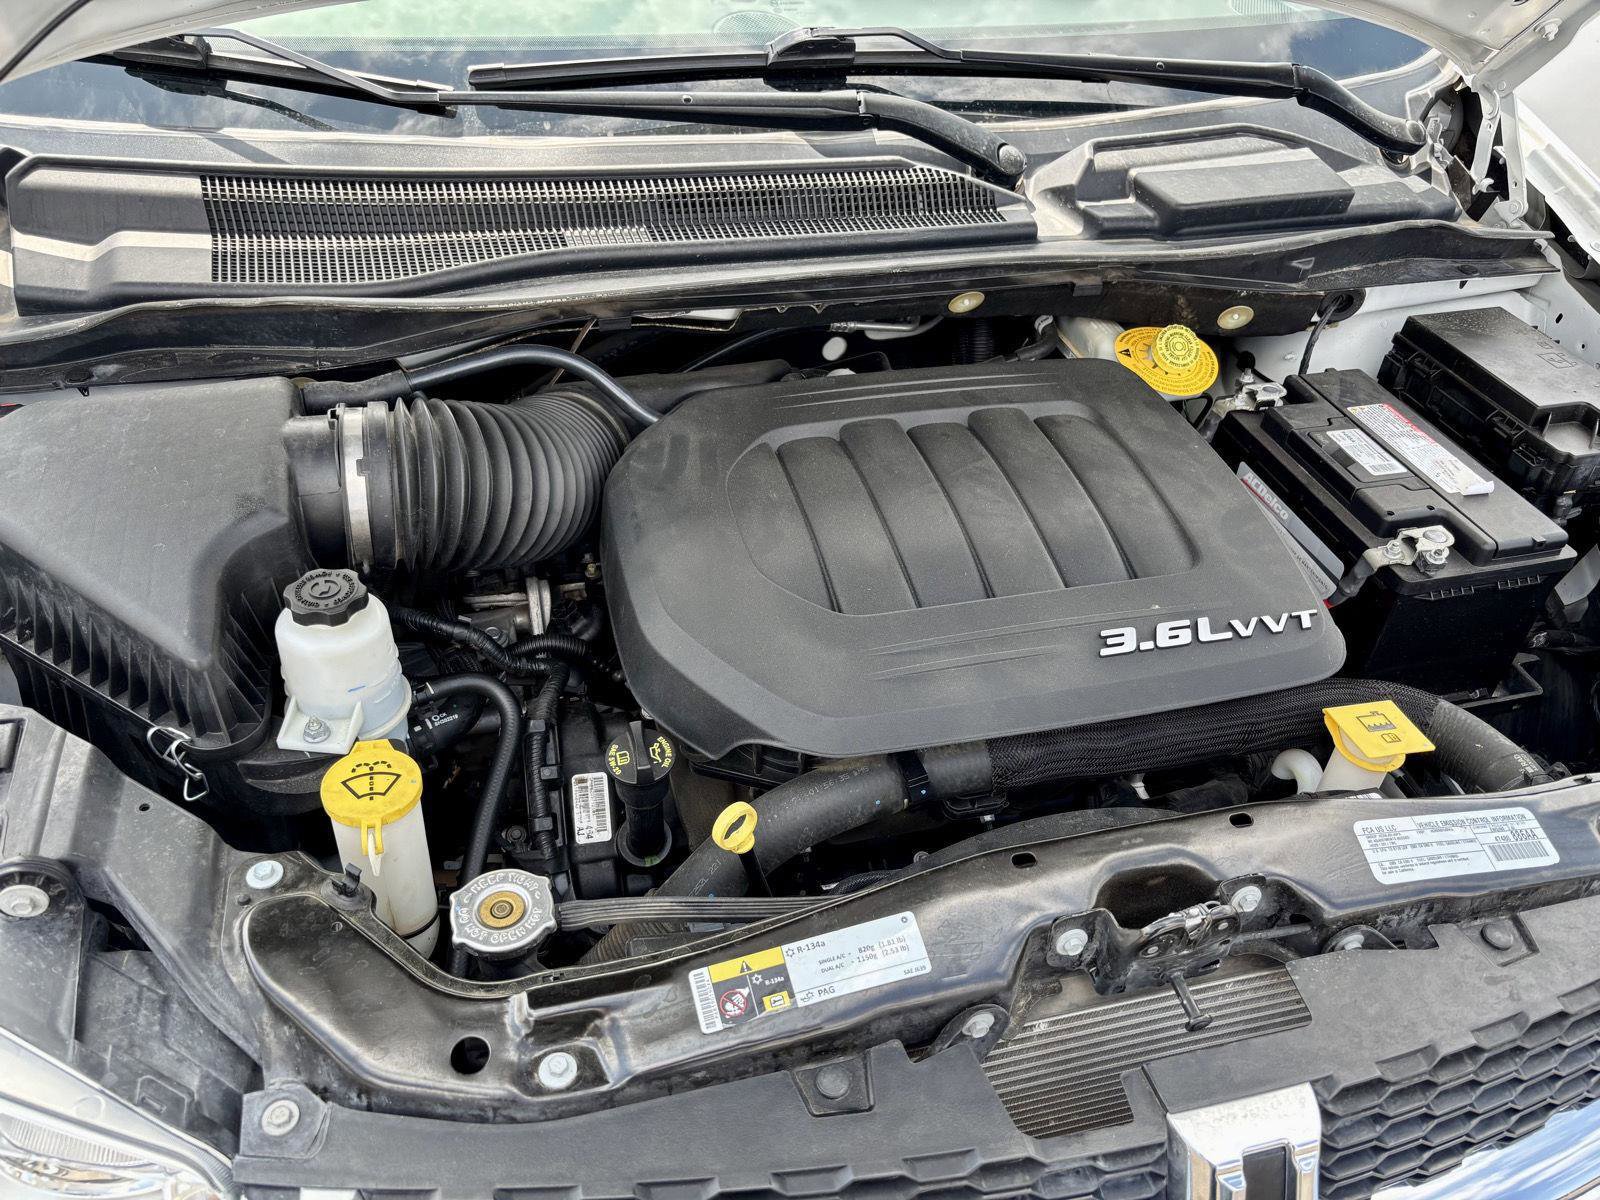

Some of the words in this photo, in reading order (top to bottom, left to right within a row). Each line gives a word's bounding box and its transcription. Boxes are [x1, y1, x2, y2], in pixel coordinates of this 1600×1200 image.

[1099, 616, 1233, 657] 3.6L
[1229, 609, 1318, 638] VVT
[609, 743, 619, 757] SAE
[657, 735, 673, 758] ENGINE
[609, 756, 622, 776] 5W-20
[661, 757, 672, 769] OIL
[1416, 821, 1440, 829] VEHICLE
[1440, 819, 1466, 827] EMISSION
[1466, 816, 1489, 825] CONTROL
[1490, 813, 1527, 822] INFORMATION
[1362, 826, 1374, 834] FCA
[1376, 825, 1386, 833] US
[1386, 824, 1397, 832] LLC
[470, 872, 506, 894] KEEP
[459, 907, 470, 923] DO
[465, 924, 489, 940] NOT
[490, 927, 526, 944] OPEN
[796, 940, 826, 954] R-134a
[818, 956, 835, 965] SINGLE
[816, 985, 836, 997] PAG
